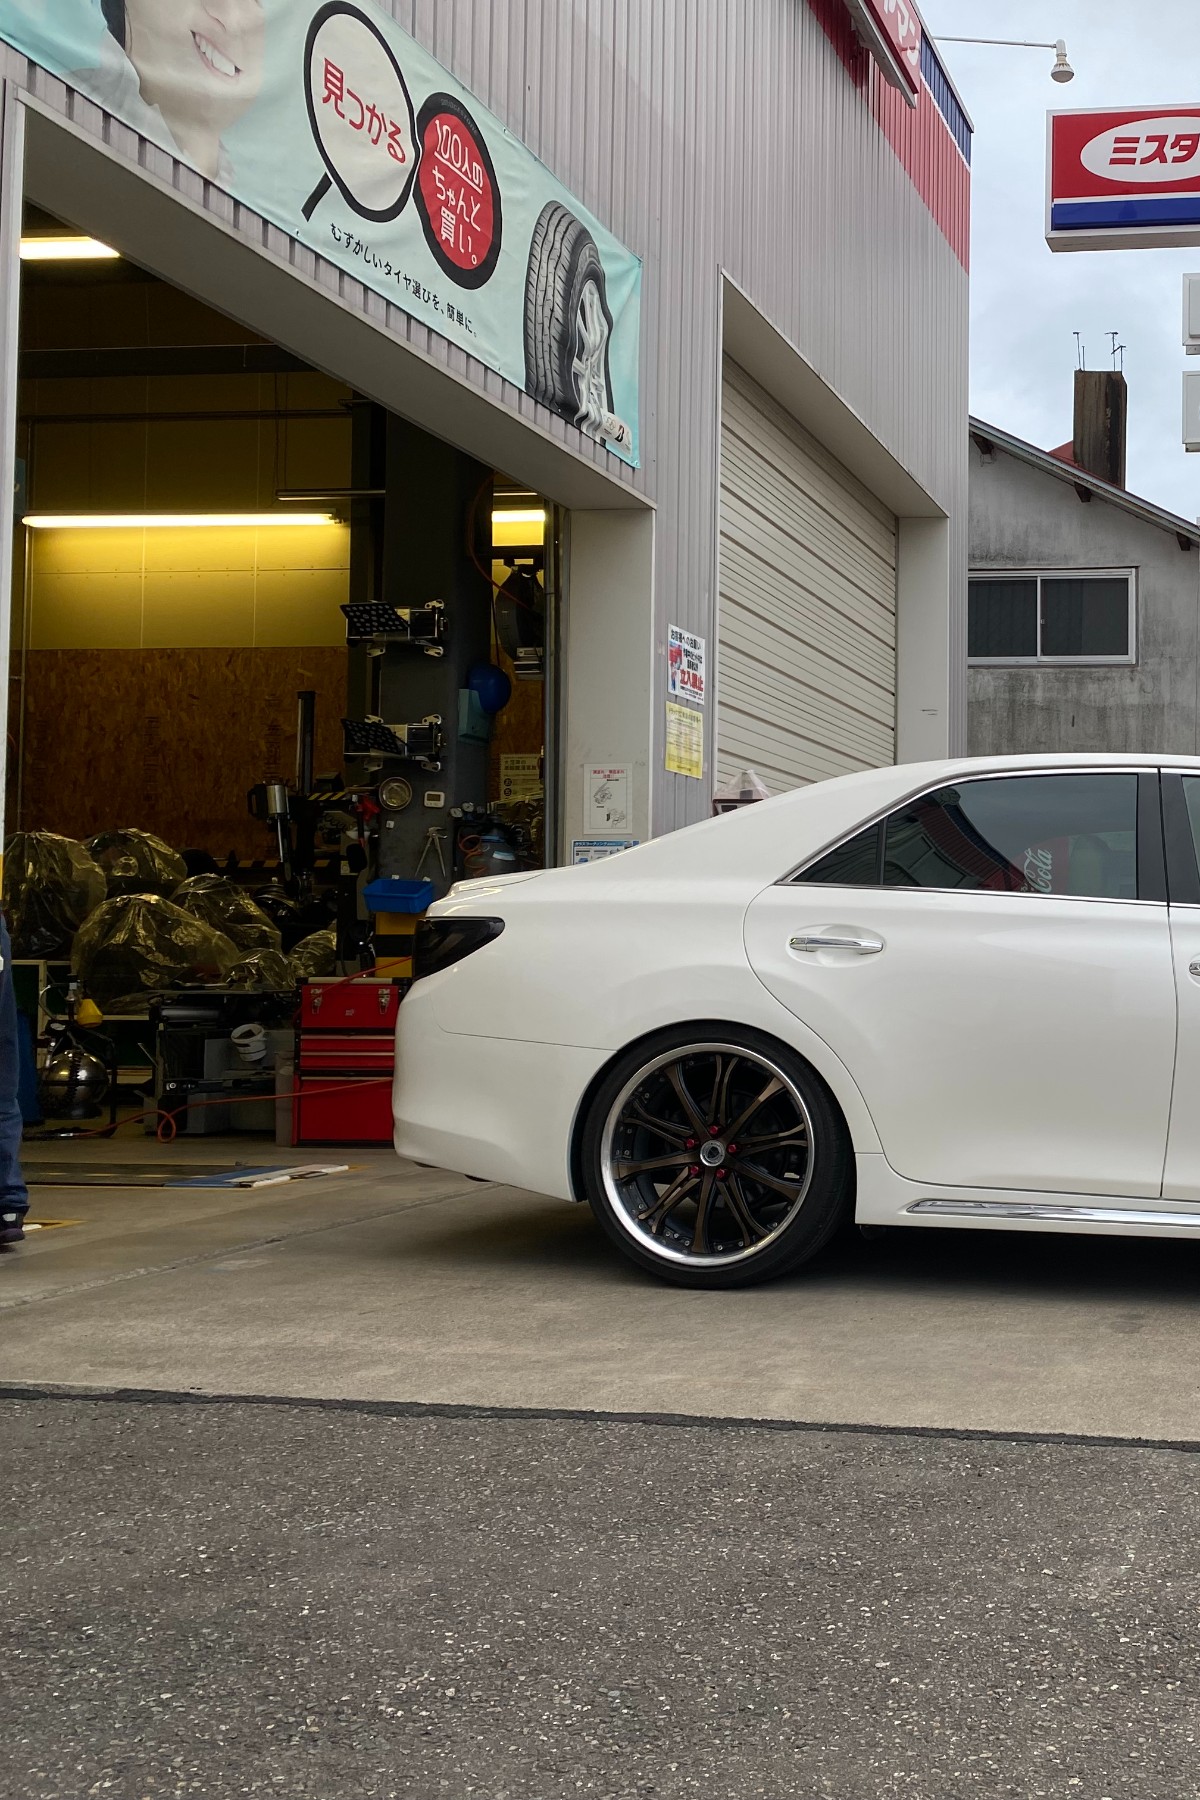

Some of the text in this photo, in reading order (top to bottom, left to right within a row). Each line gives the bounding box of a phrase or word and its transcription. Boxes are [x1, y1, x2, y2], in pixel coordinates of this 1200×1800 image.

[883, 0, 920, 66] マン
[322, 57, 406, 164] 見つかる
[434, 119, 484, 189] 100人の
[432, 165, 482, 232] ちゃんと
[440, 206, 477, 265] 買い。
